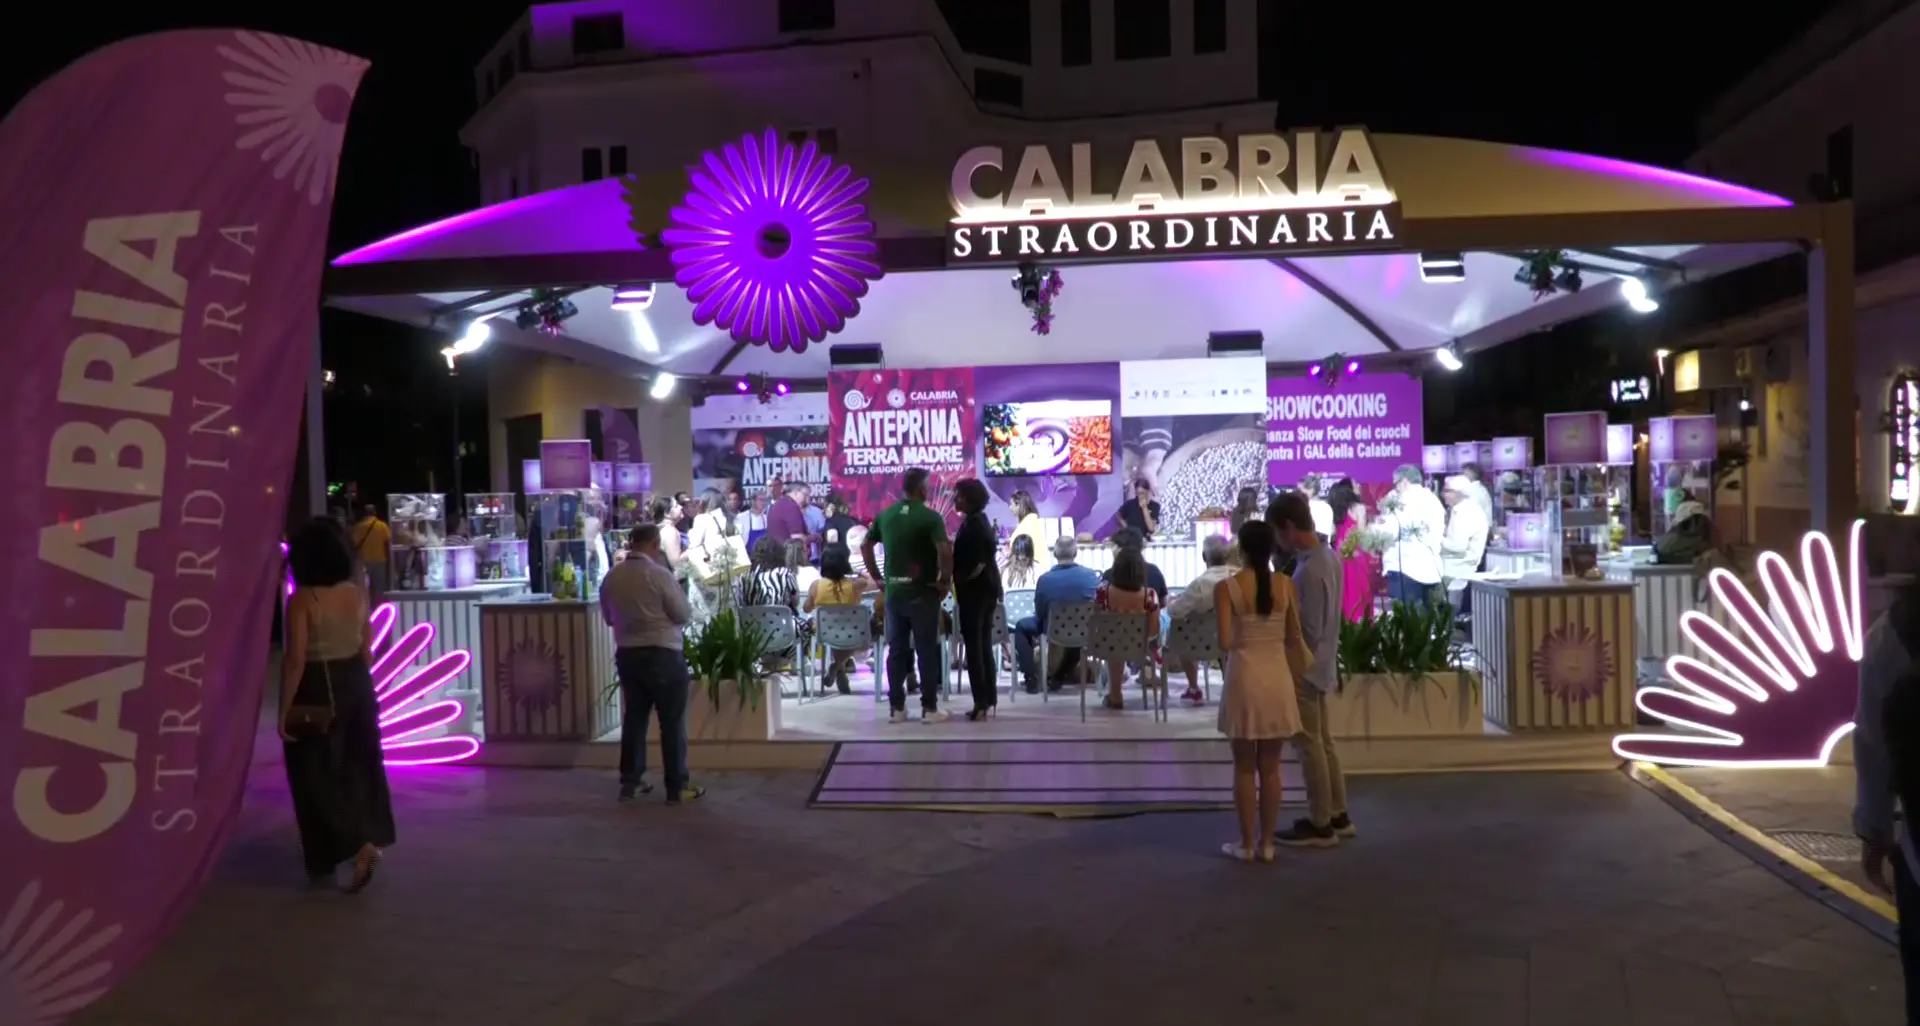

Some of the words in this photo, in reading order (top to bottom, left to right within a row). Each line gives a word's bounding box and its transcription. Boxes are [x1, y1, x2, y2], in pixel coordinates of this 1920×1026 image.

[949, 129, 1390, 214] CALABRIA
[953, 209, 1394, 258] STRAORDINARIA
[910, 390, 958, 401] CALABRIA
[1266, 392, 1388, 421] SHOWCOOKING
[843, 407, 963, 447] ANTEPRIMA
[1297, 425, 1323, 442] Slow
[1327, 424, 1352, 441] Food
[1354, 424, 1372, 440] dei
[1375, 423, 1410, 439] cuochi
[843, 447, 900, 466] TERRA
[903, 445, 963, 463] MADRE
[1304, 443, 1326, 460] GAL
[1328, 442, 1354, 458] della
[1357, 441, 1402, 458] Calabria
[742, 455, 832, 485] ANTEPRIMA
[844, 466, 868, 475] 19-21
[869, 465, 904, 475] GIUGNO
[12, 210, 201, 843] CALABRIA
[152, 223, 258, 832] STRAORDINARIA
